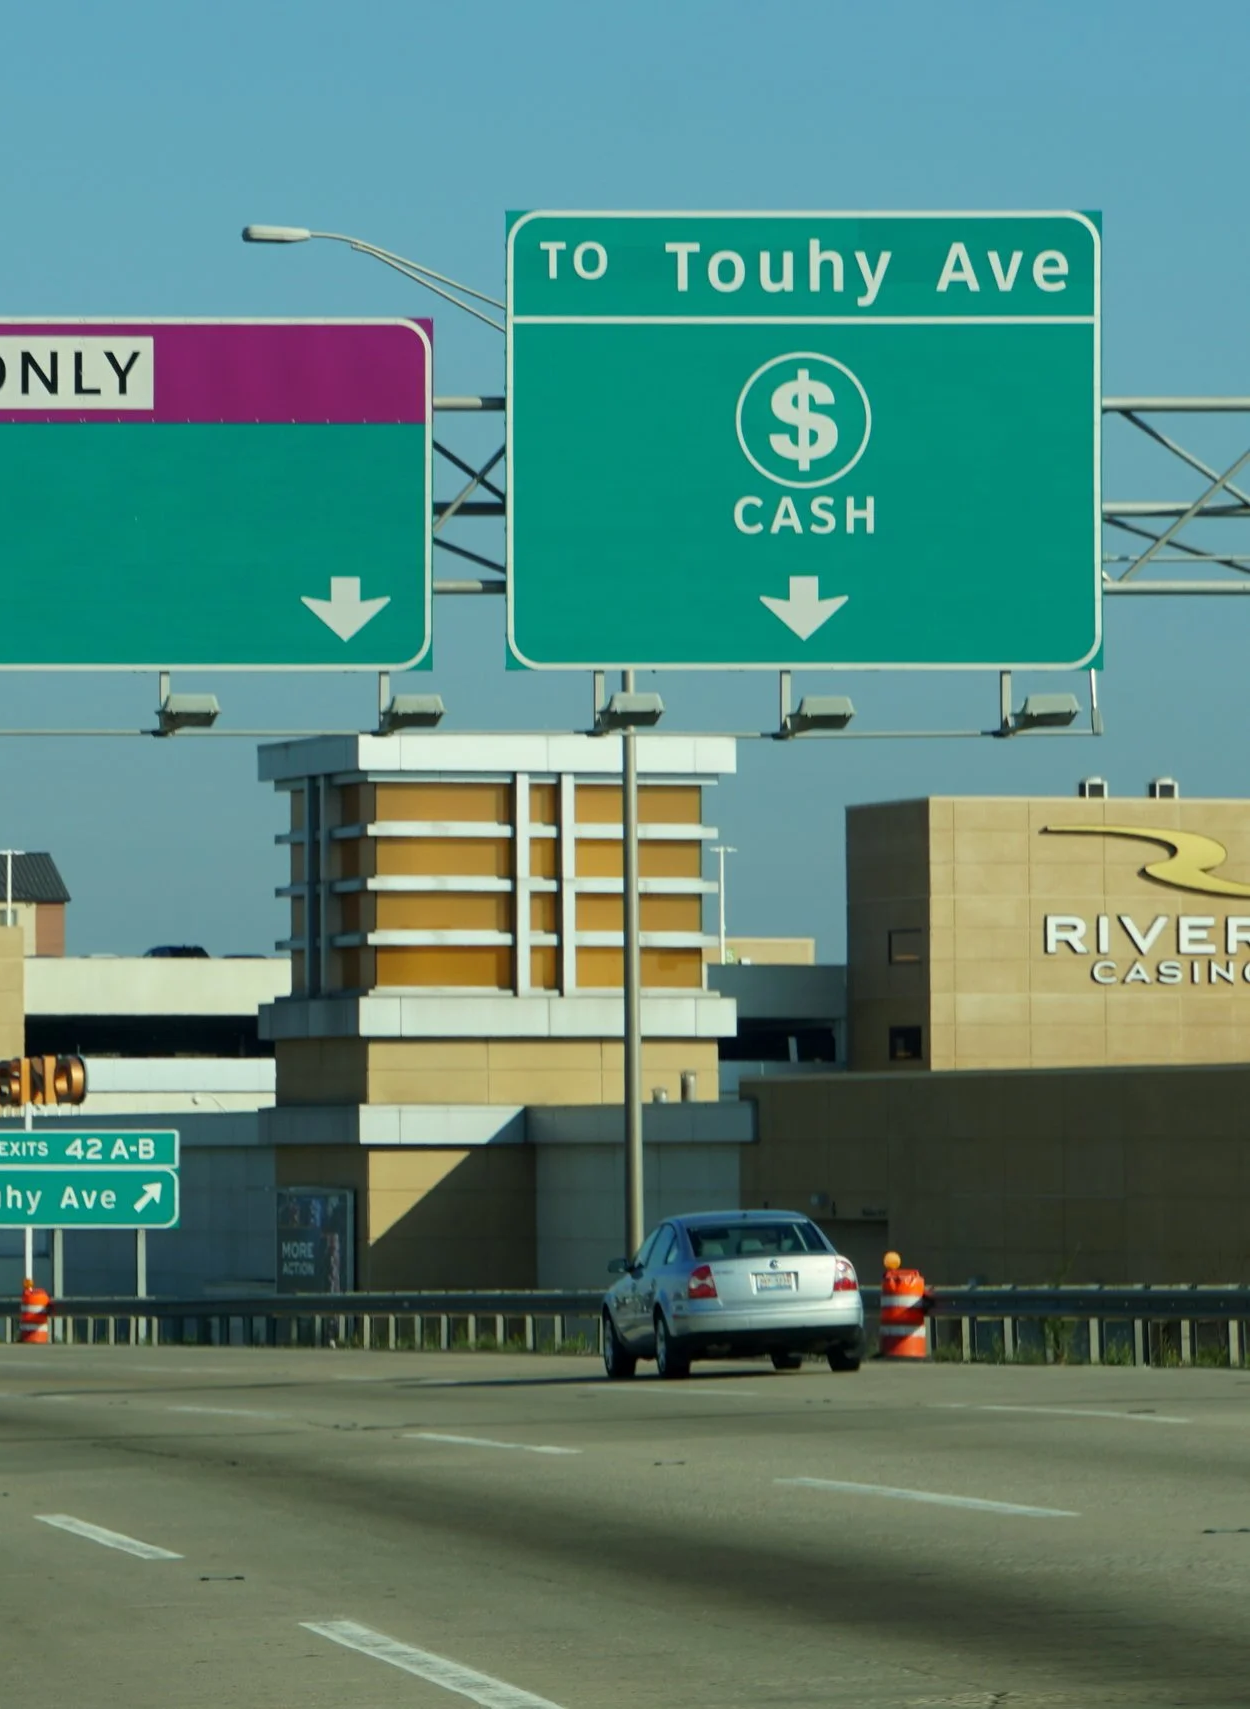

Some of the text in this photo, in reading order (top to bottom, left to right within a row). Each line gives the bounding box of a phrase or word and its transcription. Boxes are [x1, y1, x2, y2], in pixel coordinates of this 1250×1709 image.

[540, 238, 1069, 307] TO Touhy Ave
[733, 495, 876, 534] CASH
[1090, 960, 1250, 985] CASIN
[65, 1138, 103, 1160] 42
[110, 1138, 156, 1160] A-B
[60, 1186, 118, 1209] Ave
[282, 1242, 315, 1258] MORE
[282, 1261, 315, 1276] ACTION
